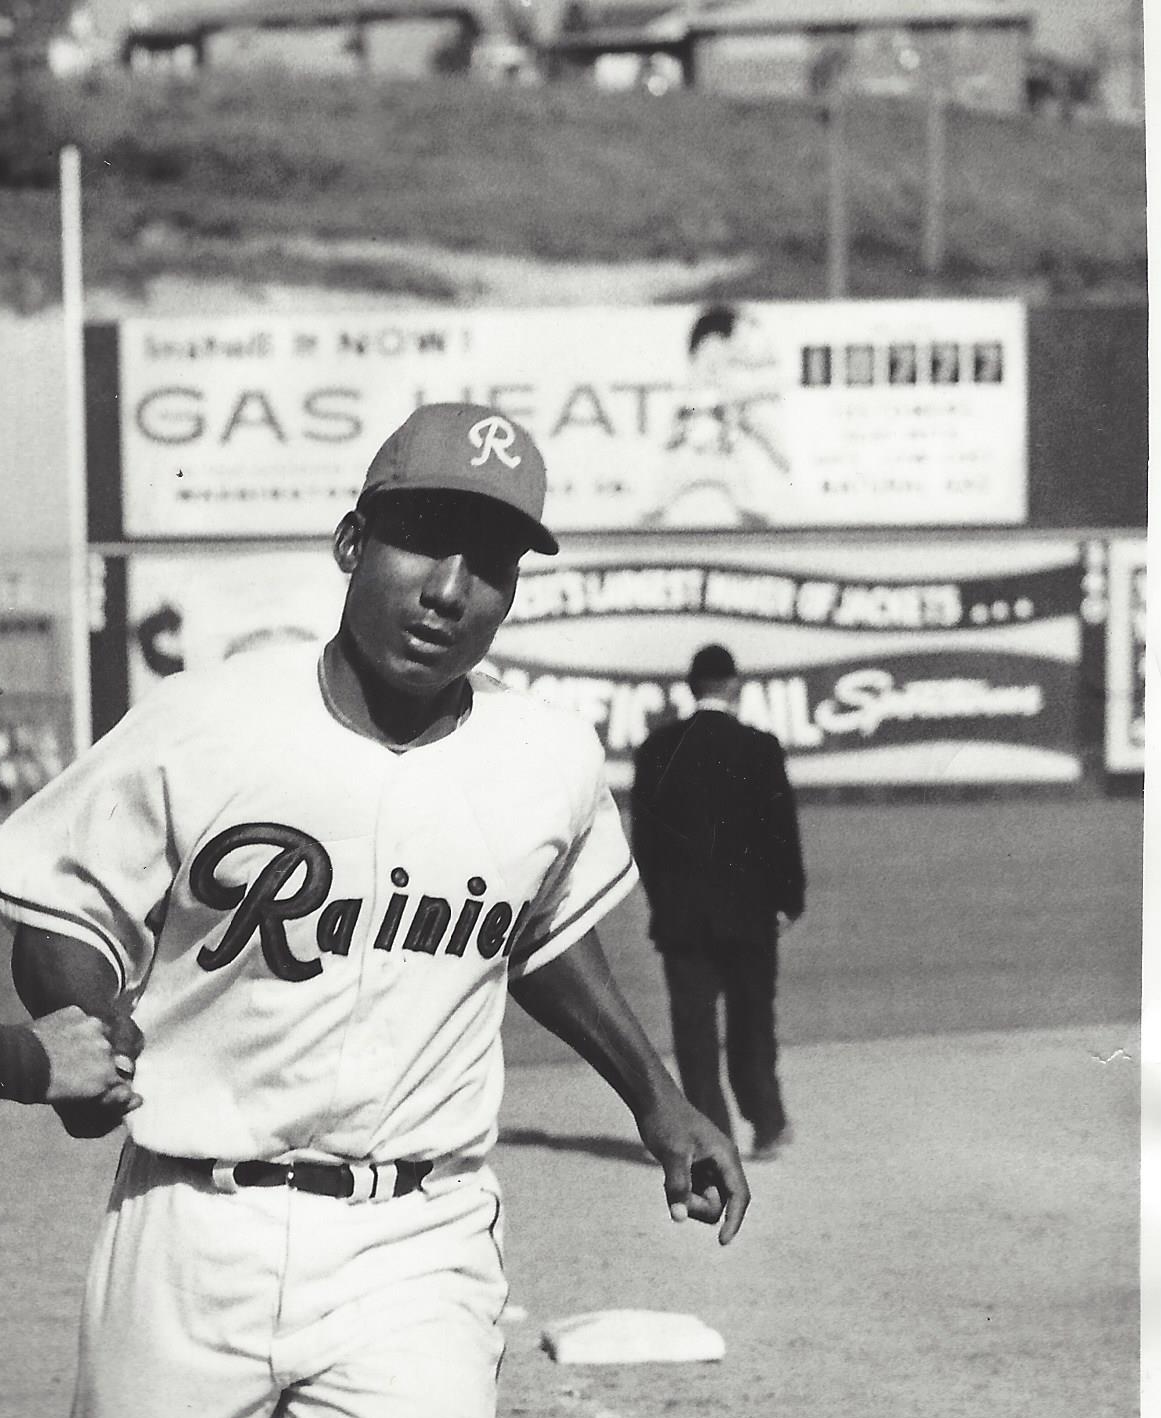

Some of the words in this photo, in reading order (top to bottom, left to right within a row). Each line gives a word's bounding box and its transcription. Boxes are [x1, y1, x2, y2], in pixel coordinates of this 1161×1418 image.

[338, 328, 503, 356] NOW!
[135, 385, 363, 445] GAS
[468, 416, 521, 469] R
